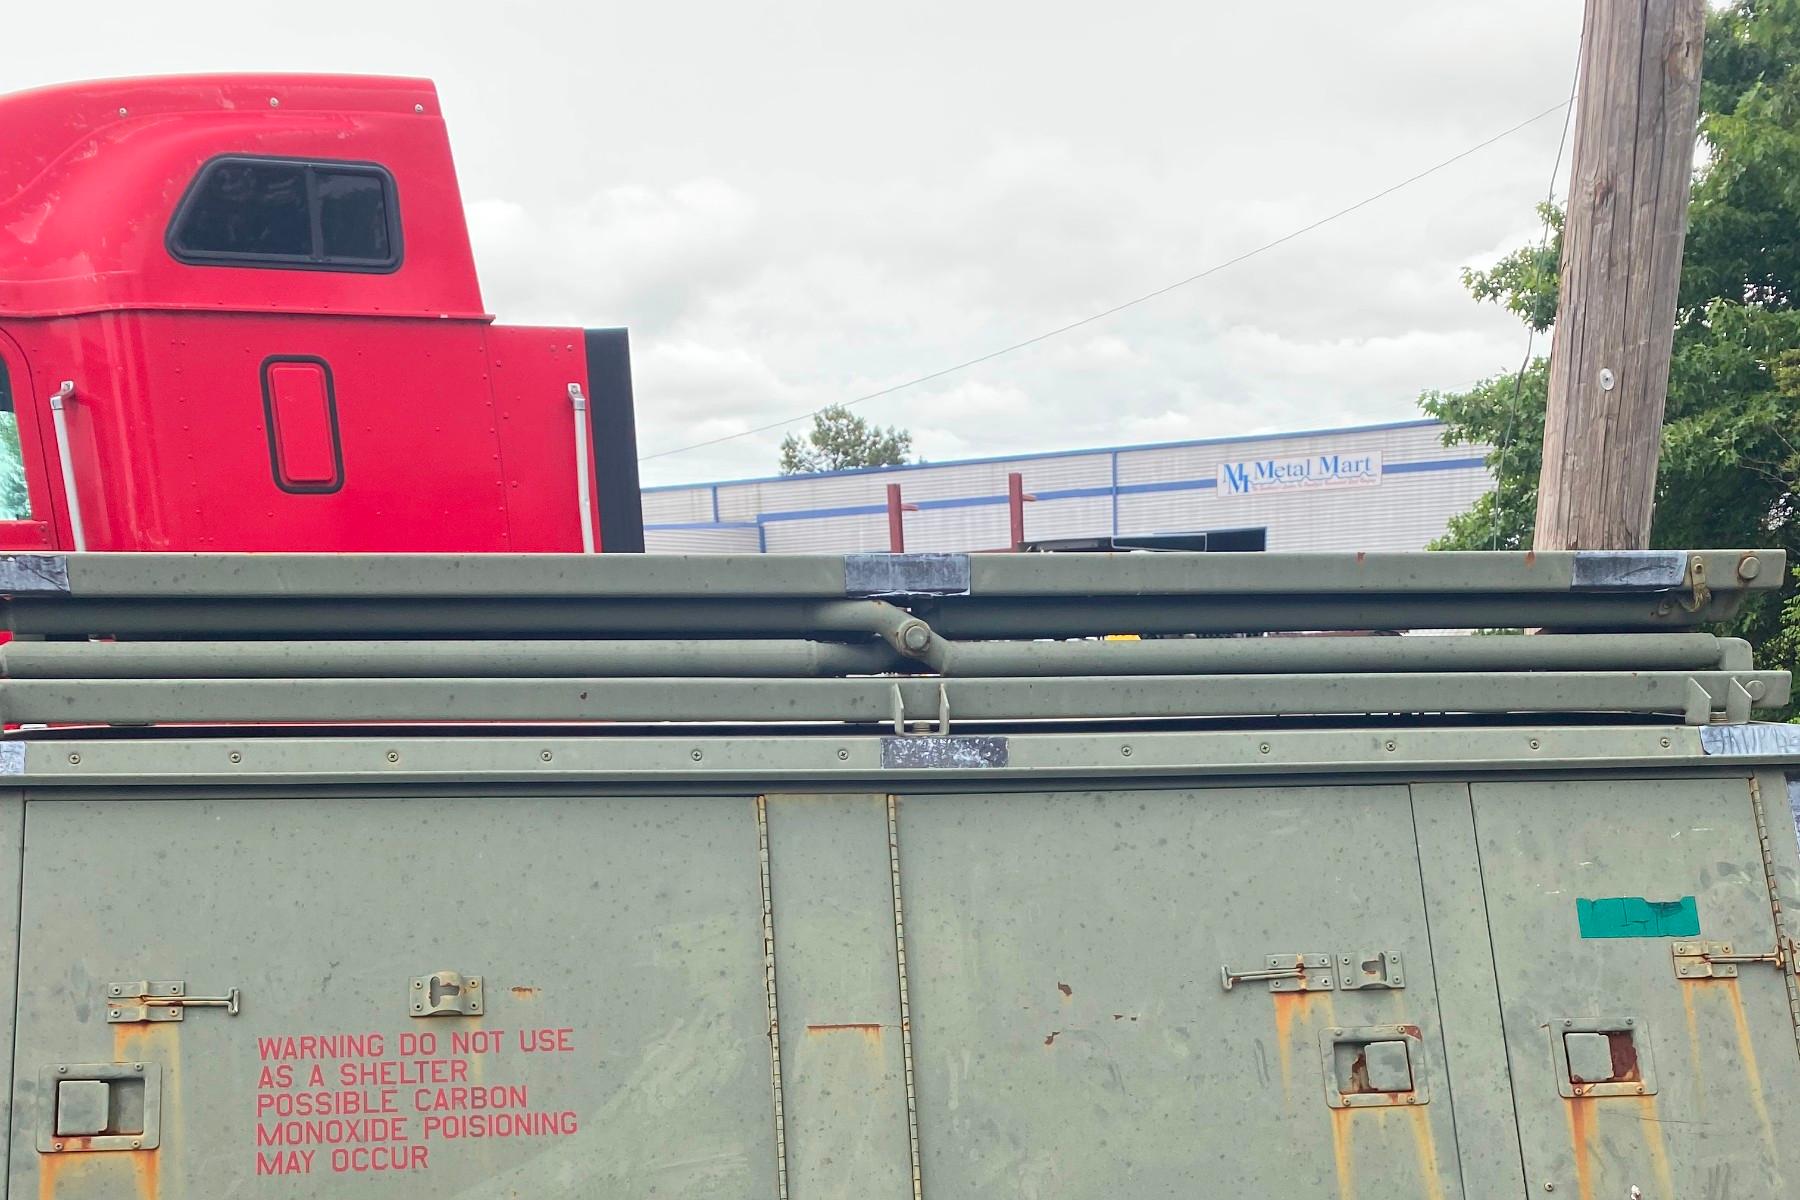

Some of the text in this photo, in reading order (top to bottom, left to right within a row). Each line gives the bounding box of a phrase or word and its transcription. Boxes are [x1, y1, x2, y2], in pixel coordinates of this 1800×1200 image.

[1254, 455, 1372, 479] Metal Mart
[257, 1028, 575, 1060] WARNING DO NOT USE
[258, 1060, 469, 1089] AS A SHELTER
[257, 1085, 528, 1117] POSSIBLE CARBON
[257, 1111, 578, 1146] MONOXIDE POISIONING
[257, 1146, 429, 1175] MAY OCCUR
